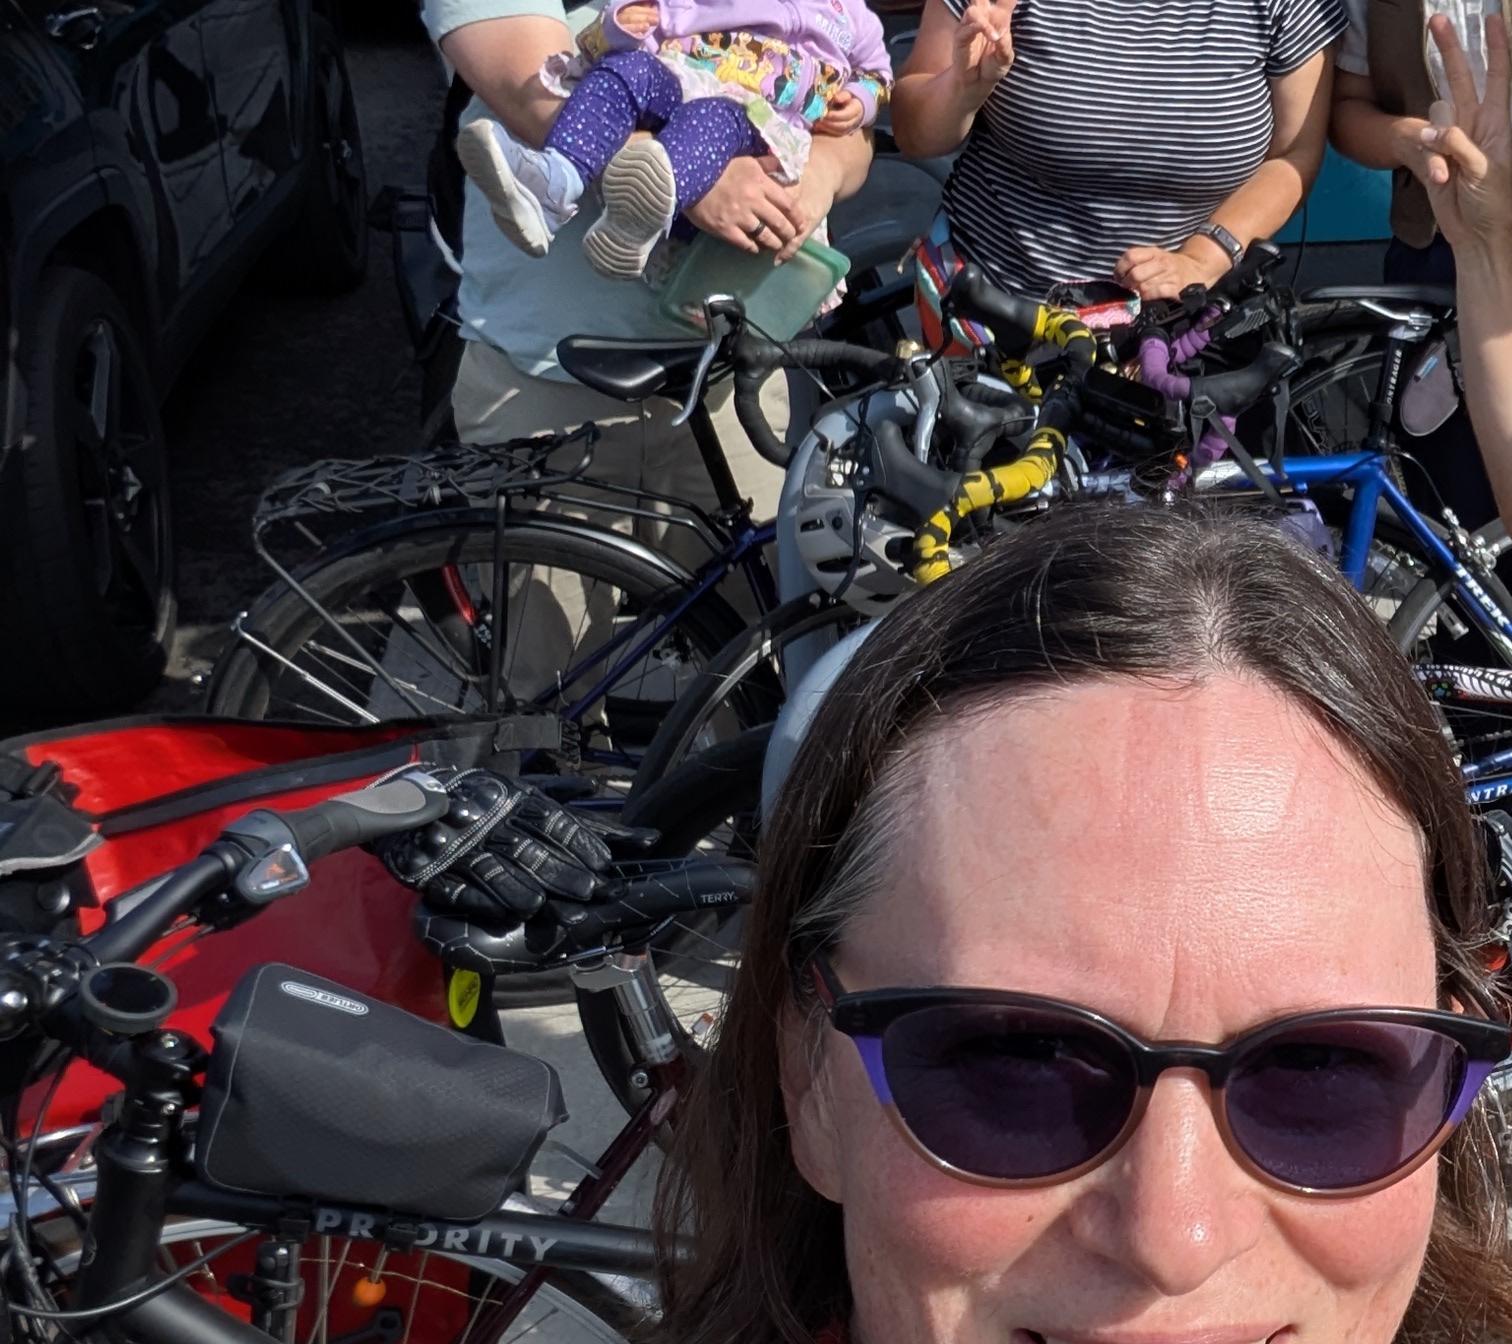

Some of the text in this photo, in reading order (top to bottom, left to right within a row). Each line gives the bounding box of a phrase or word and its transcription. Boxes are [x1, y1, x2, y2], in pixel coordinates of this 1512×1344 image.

[1386, 349, 1403, 405] ONTRAGER
[1455, 563, 1511, 628] TREK
[700, 890, 735, 904] TERRY
[315, 1207, 559, 1262] PRORITY
